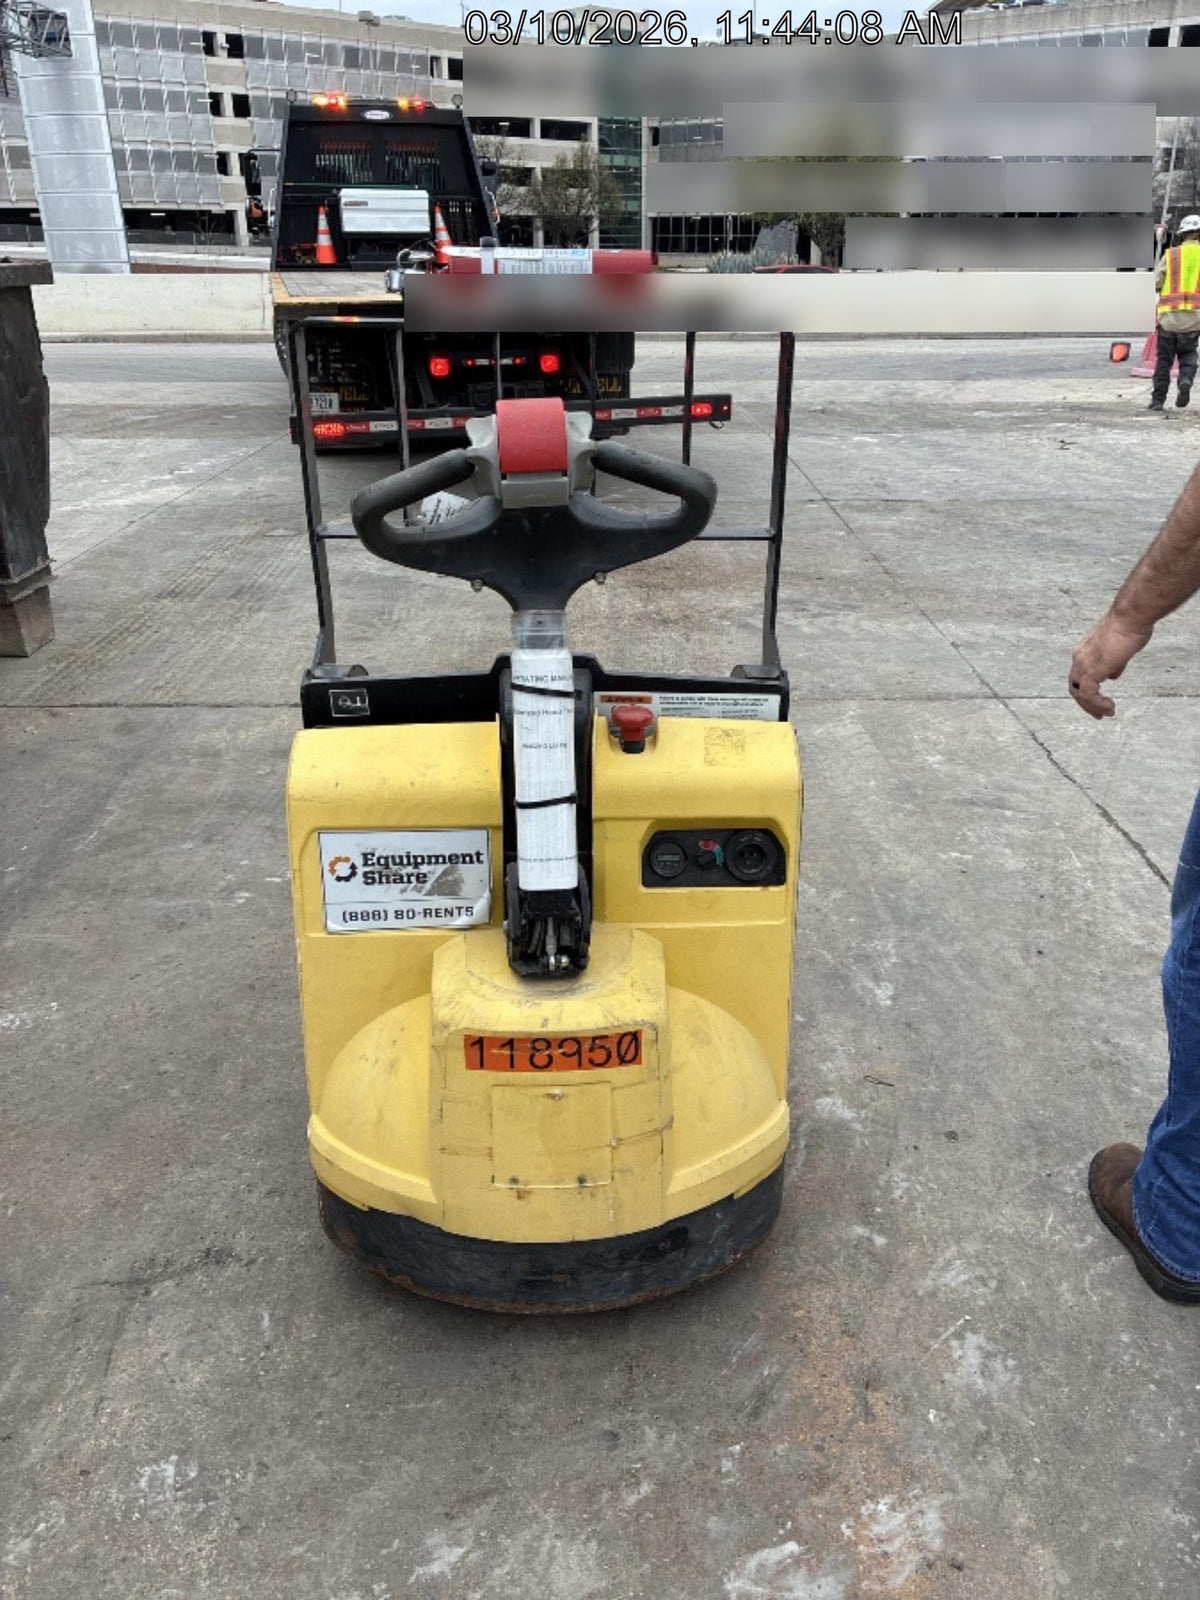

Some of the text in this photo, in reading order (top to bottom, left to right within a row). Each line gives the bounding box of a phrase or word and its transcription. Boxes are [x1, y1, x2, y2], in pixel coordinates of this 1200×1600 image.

[361, 850, 484, 869] Equipment
[361, 870, 428, 886] Share
[342, 905, 474, 923] (888) 80-RENTS
[470, 1030, 640, 1070] 118950
